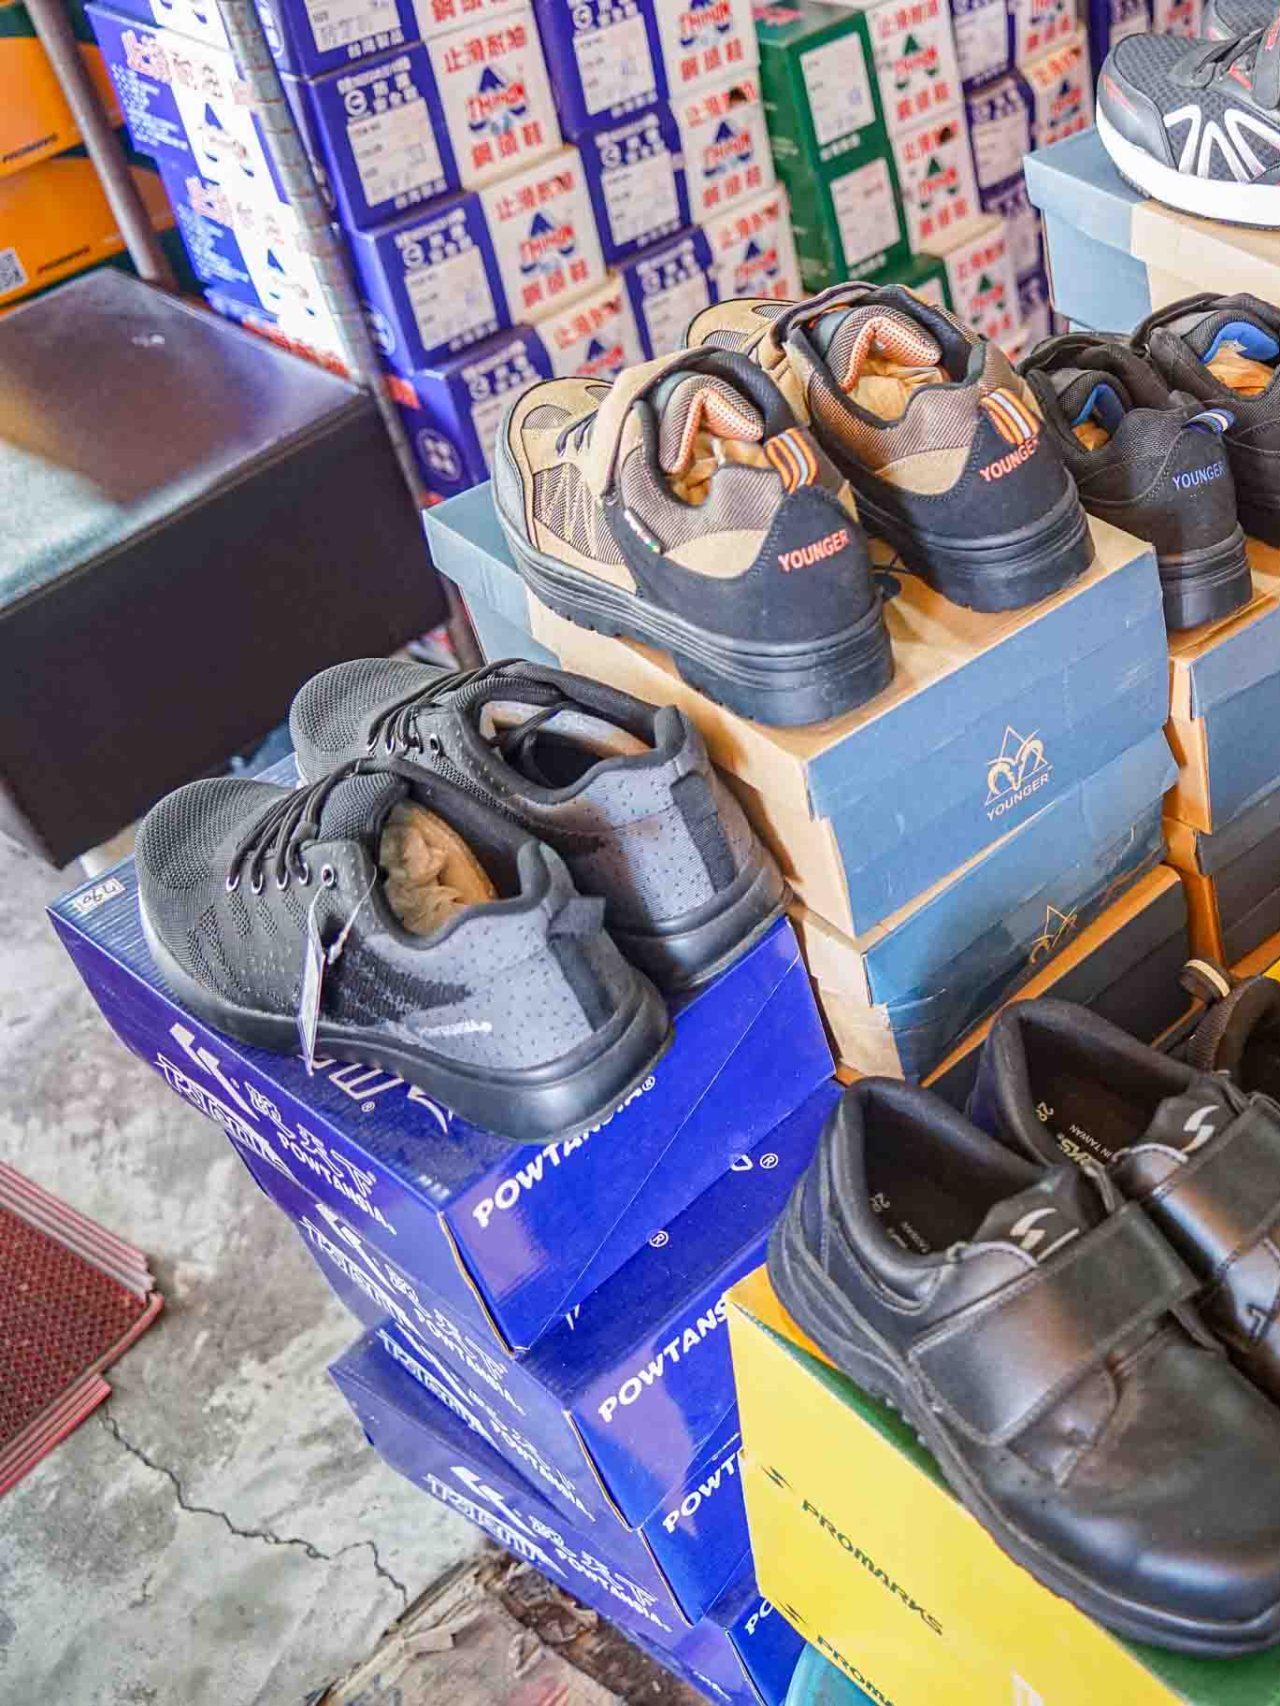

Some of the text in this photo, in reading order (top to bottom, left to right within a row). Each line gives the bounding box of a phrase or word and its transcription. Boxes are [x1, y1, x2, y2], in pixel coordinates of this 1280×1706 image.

[777, 517, 850, 573] YOUNGER
[985, 772, 1050, 822] YOUNGER
[277, 1130, 391, 1229] POWTANSIA
[472, 1090, 644, 1228] POWTA
[1069, 1124, 1102, 1152] TAIWAN
[597, 1297, 729, 1423] POWTANS
[802, 1499, 944, 1636] PROMARKS
